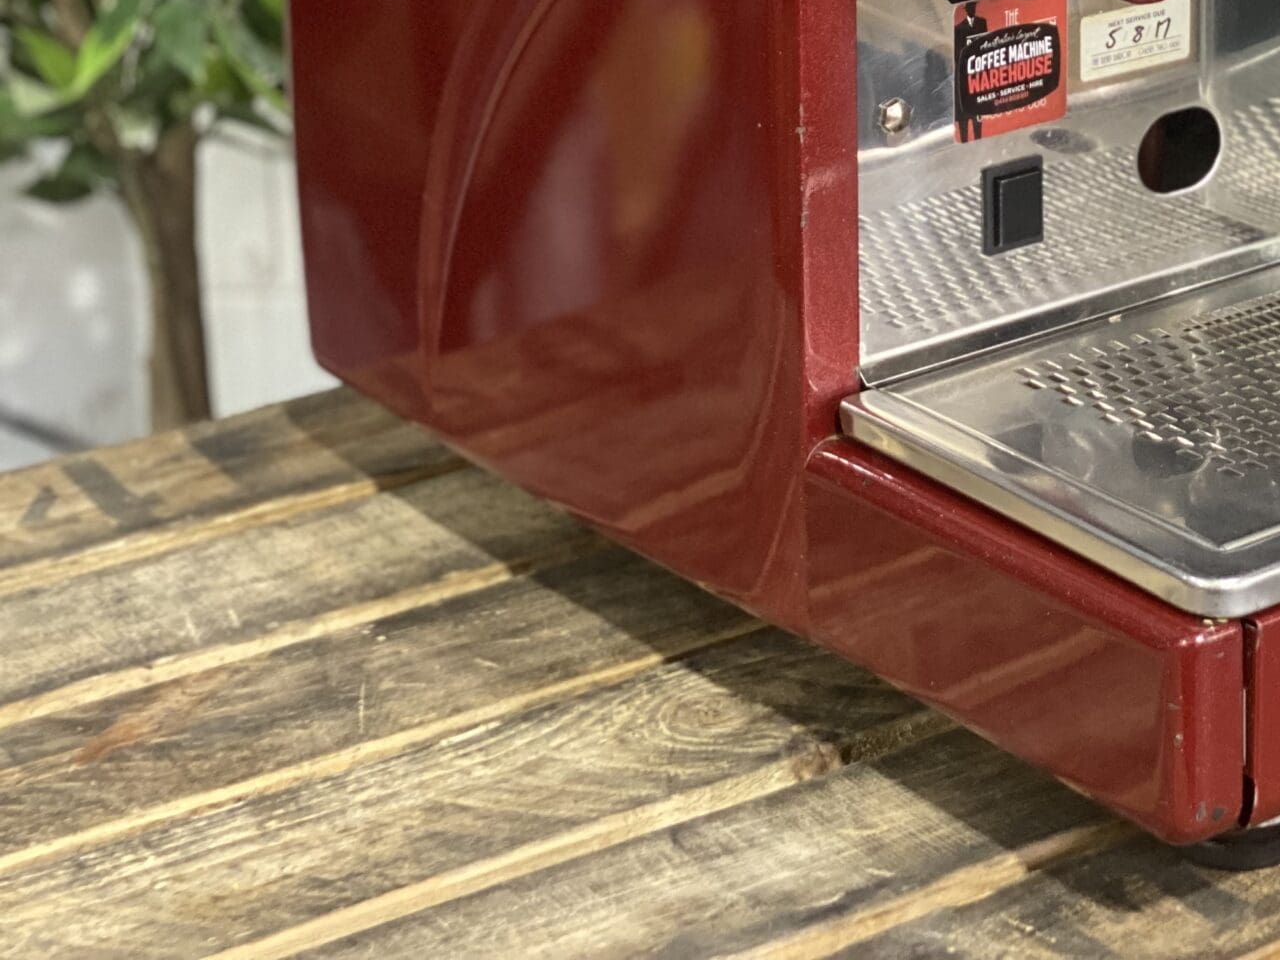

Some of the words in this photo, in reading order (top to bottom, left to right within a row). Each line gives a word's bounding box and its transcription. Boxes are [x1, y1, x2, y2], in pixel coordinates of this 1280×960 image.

[1004, 8, 1020, 28] THE
[1108, 20, 1124, 28] NEXT
[1125, 13, 1151, 25] SERVICE
[1153, 9, 1166, 18] DUE
[1106, 26, 1123, 49] 5
[1132, 25, 1145, 44] 8
[967, 46, 1007, 74] COFFEE
[1008, 35, 1053, 63] MACHINE
[968, 55, 1053, 94] WAREHOUSE
[976, 92, 996, 103] SALES
[1000, 83, 1026, 96] SERVICE
